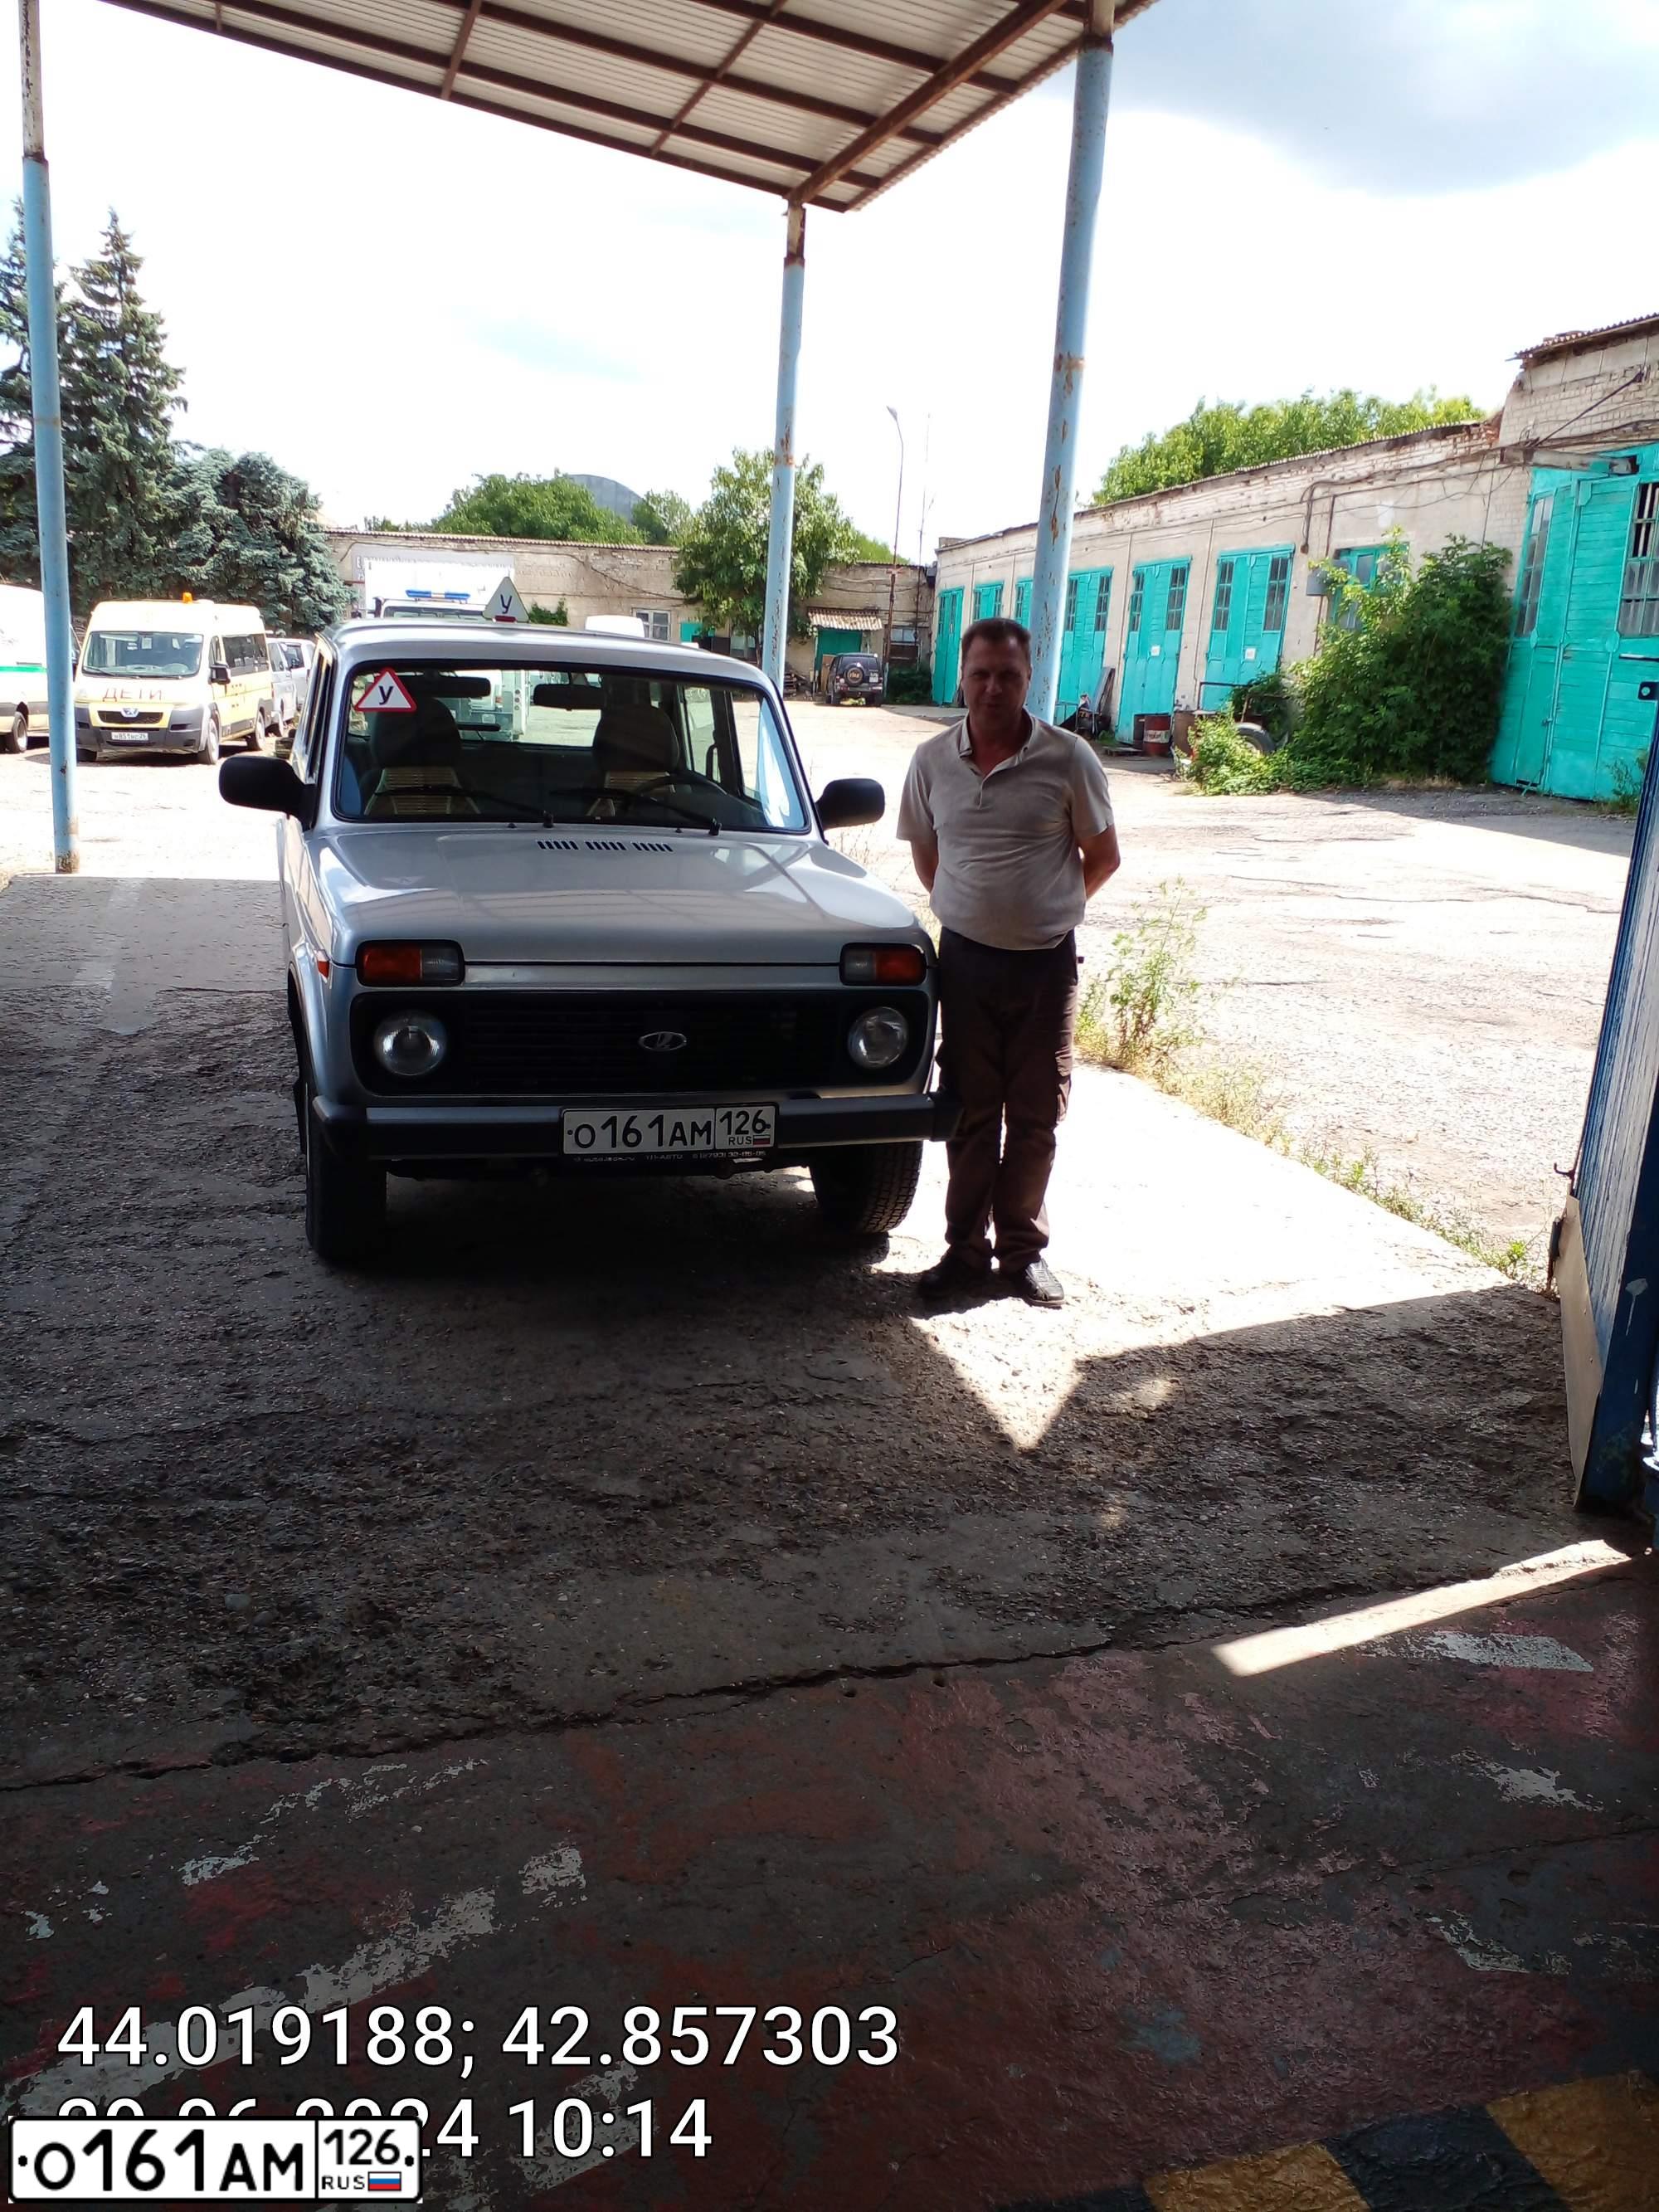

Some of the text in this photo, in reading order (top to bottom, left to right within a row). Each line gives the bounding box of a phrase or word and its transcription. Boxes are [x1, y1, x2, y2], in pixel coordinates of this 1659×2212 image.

[378, 685, 394, 705] У
[574, 1109, 766, 1149] О161АМ 126
[728, 1136, 752, 1146] RUS
